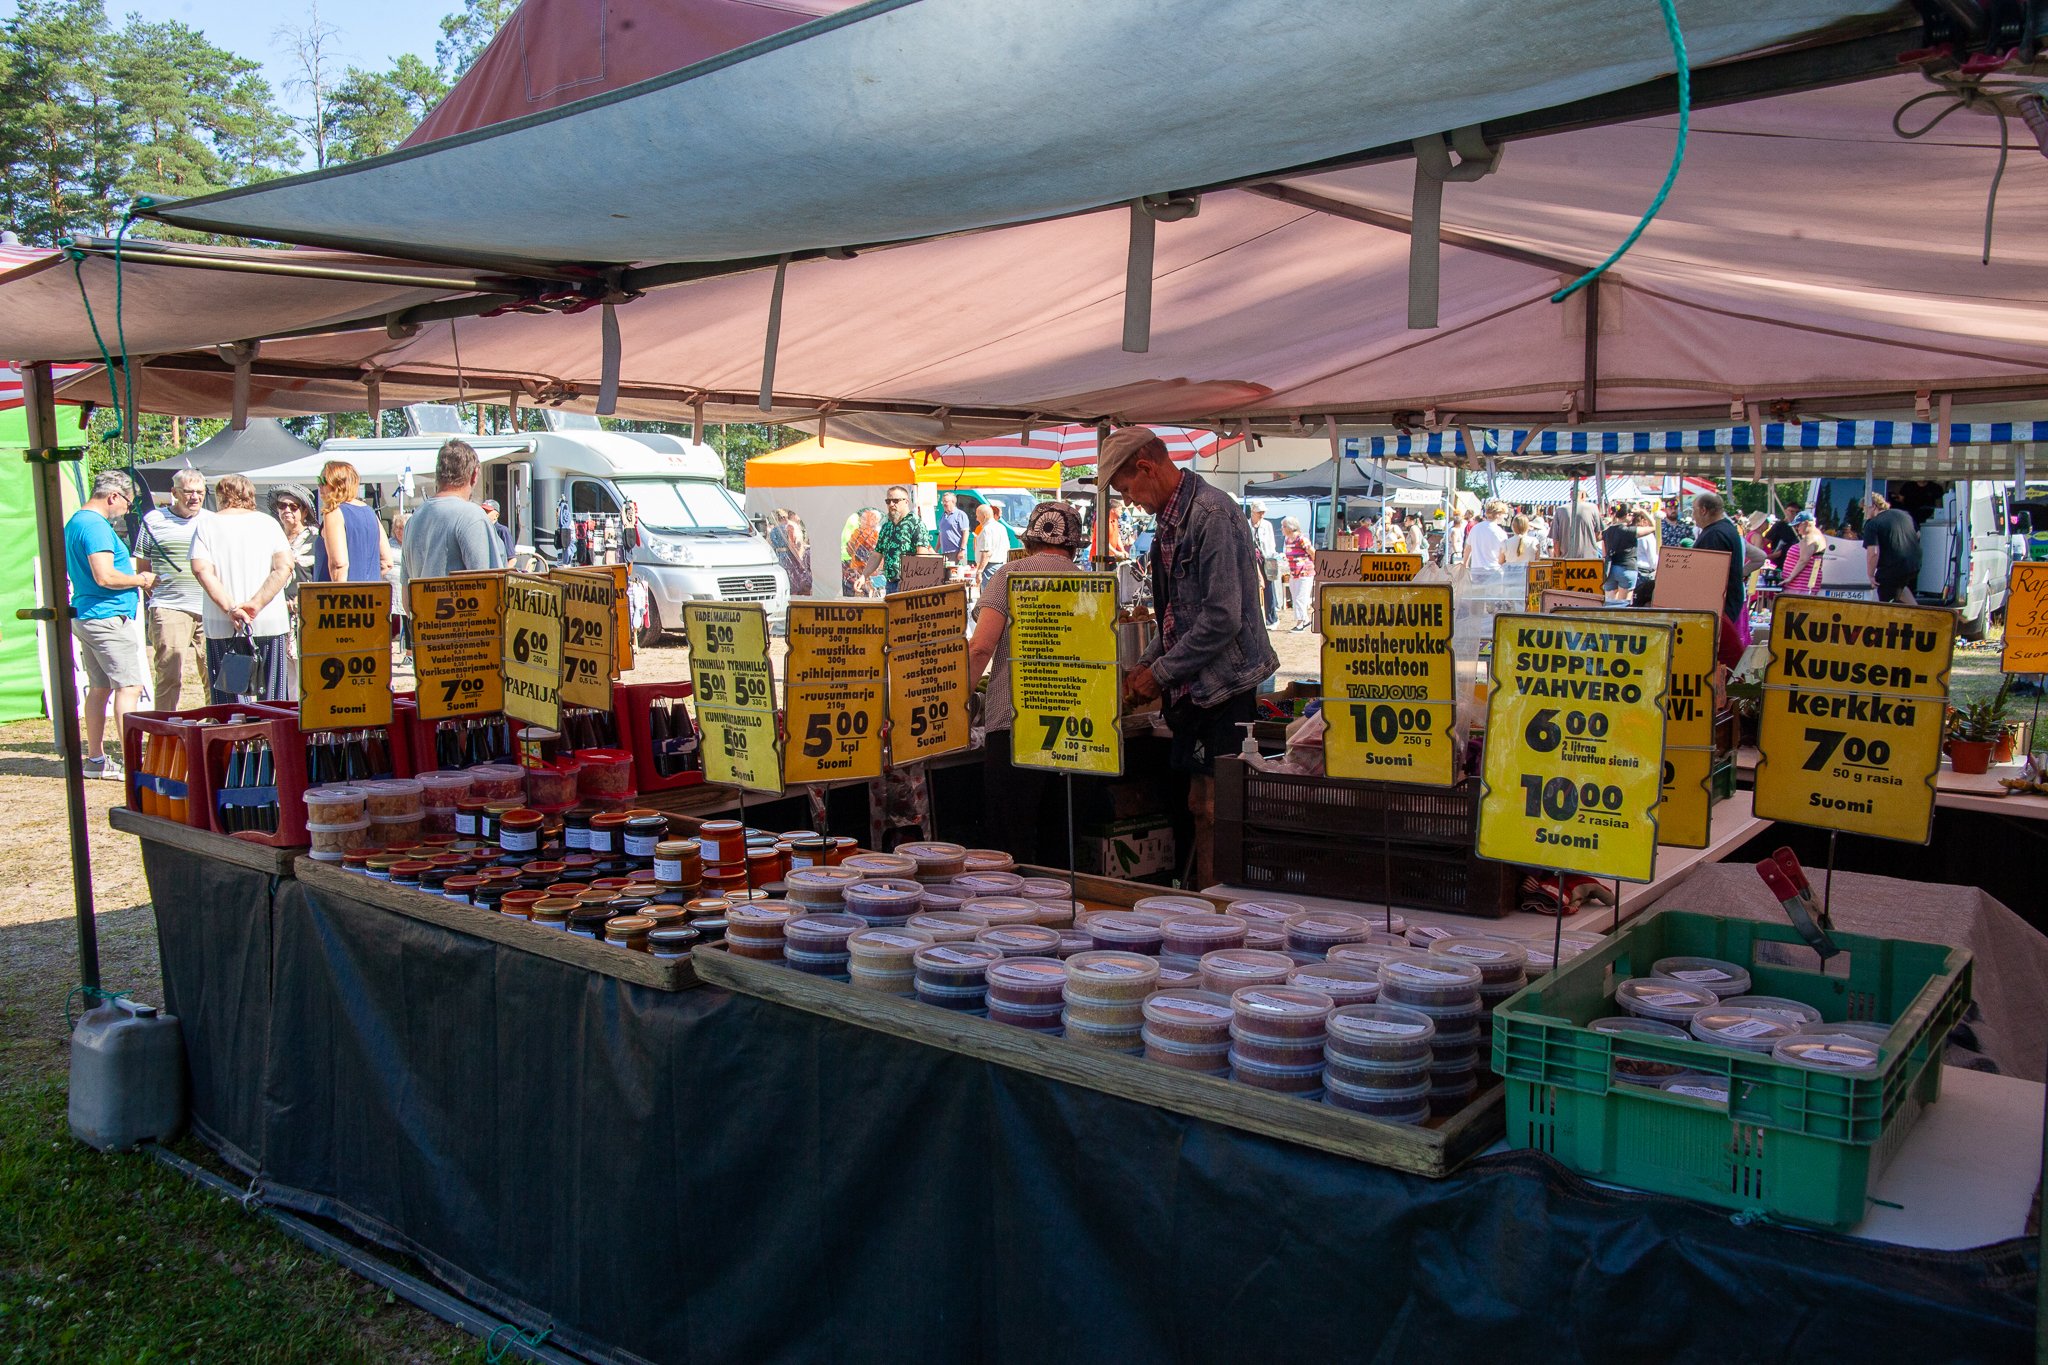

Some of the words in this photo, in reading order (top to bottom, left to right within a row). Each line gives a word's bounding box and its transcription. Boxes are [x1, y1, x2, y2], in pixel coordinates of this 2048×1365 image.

[1317, 559, 1361, 579] Mustik
[1372, 561, 1411, 571] HILLOT:
[1566, 568, 1598, 579] KKA
[423, 581, 487, 593] Mansikkamehu
[564, 579, 610, 606] KIVÄÄRI
[1011, 579, 1113, 593] MARJAJAUHEET
[316, 594, 382, 610] TYRNI-
[507, 586, 559, 619] PAPAIJA
[905, 593, 946, 611] HILLOT
[318, 613, 375, 629] MEHU
[815, 607, 864, 621] HILLOT
[1330, 603, 1443, 627] MARJAJAUHE
[417, 617, 497, 630] Pihlajanmarjamehu
[837, 624, 884, 635] mansikka
[421, 628, 495, 641] Ruusunmarjamehu
[1783, 610, 1937, 654] Kuivattu
[427, 640, 490, 652] Saskatoonmehu
[1516, 629, 1647, 656] KUIVATTU
[431, 652, 488, 664] Vadelmamehu
[420, 663, 499, 677] Variksenmarjamehu
[727, 660, 767, 672] TYRNIHILLO
[1515, 654, 1643, 679] SUPPILO-
[1783, 648, 1928, 688] Kuusen-
[351, 678, 368, 687] 0,5
[507, 676, 558, 705] PAPAIJA
[1346, 684, 1429, 700] TARJOUS
[1514, 676, 1642, 704] VAHVERO
[330, 704, 366, 715] Suomi
[447, 699, 478, 711] Suomi
[1787, 684, 1917, 727] kerkkä
[932, 721, 945, 732] kpl
[840, 740, 859, 755] kpl
[917, 735, 946, 748] Suomi
[1064, 741, 1079, 750] 100
[1081, 743, 1087, 753] g
[1090, 743, 1110, 753] rasia
[1403, 736, 1422, 745] 250
[1424, 738, 1431, 748] g
[1561, 740, 1568, 749] 2
[1570, 740, 1597, 755] litraa
[817, 756, 852, 769] Suomi
[1051, 751, 1079, 762] Suomi
[1365, 752, 1413, 766] Suomi
[1561, 750, 1606, 766] kuivattua
[1608, 755, 1639, 769] sientä
[1832, 767, 1850, 780] 50
[1853, 772, 1863, 785] g
[1866, 774, 1904, 788] rasia
[1808, 792, 1873, 815] Suomi
[1577, 813, 1585, 823] 2
[1588, 814, 1630, 830] rasiaa
[1534, 827, 1599, 851] Suomi
